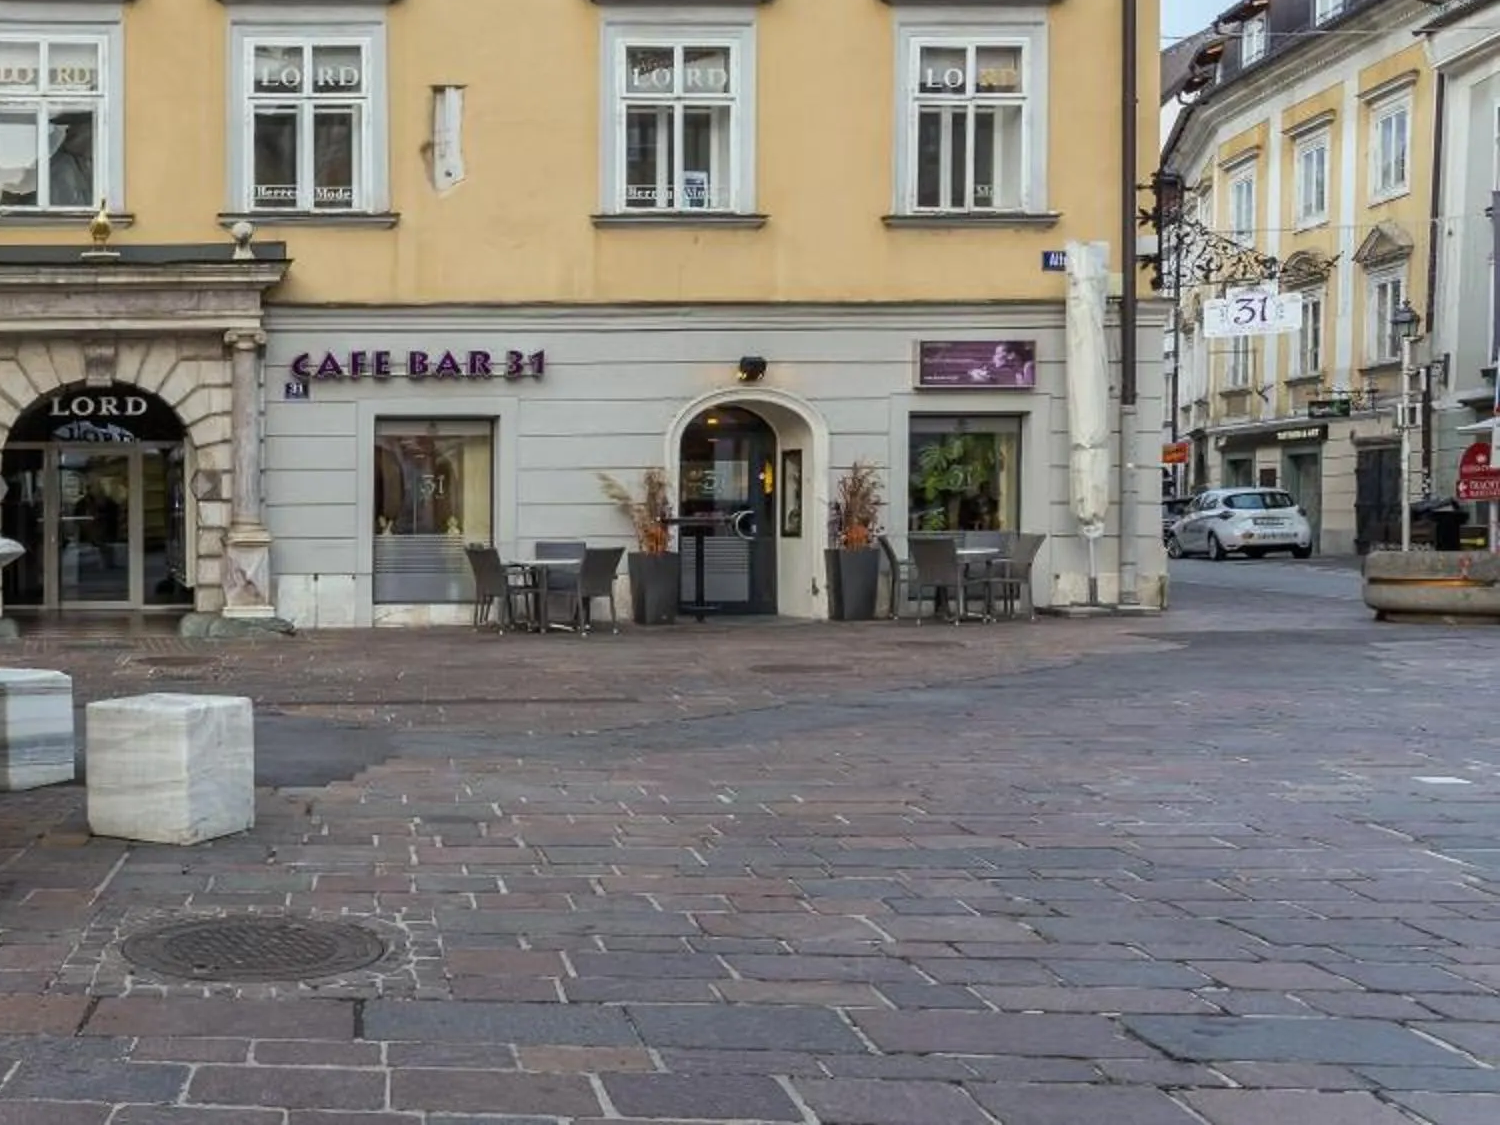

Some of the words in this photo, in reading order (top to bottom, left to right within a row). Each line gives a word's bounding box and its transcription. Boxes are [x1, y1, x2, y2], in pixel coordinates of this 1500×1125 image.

[261, 65, 359, 87] LORD
[632, 67, 728, 88] LORD
[257, 186, 299, 200] Herre
[1233, 296, 1268, 324] 31
[291, 349, 392, 379] CAFE
[408, 349, 494, 379] BAR
[505, 349, 546, 378] 31
[50, 396, 148, 416] LORD
